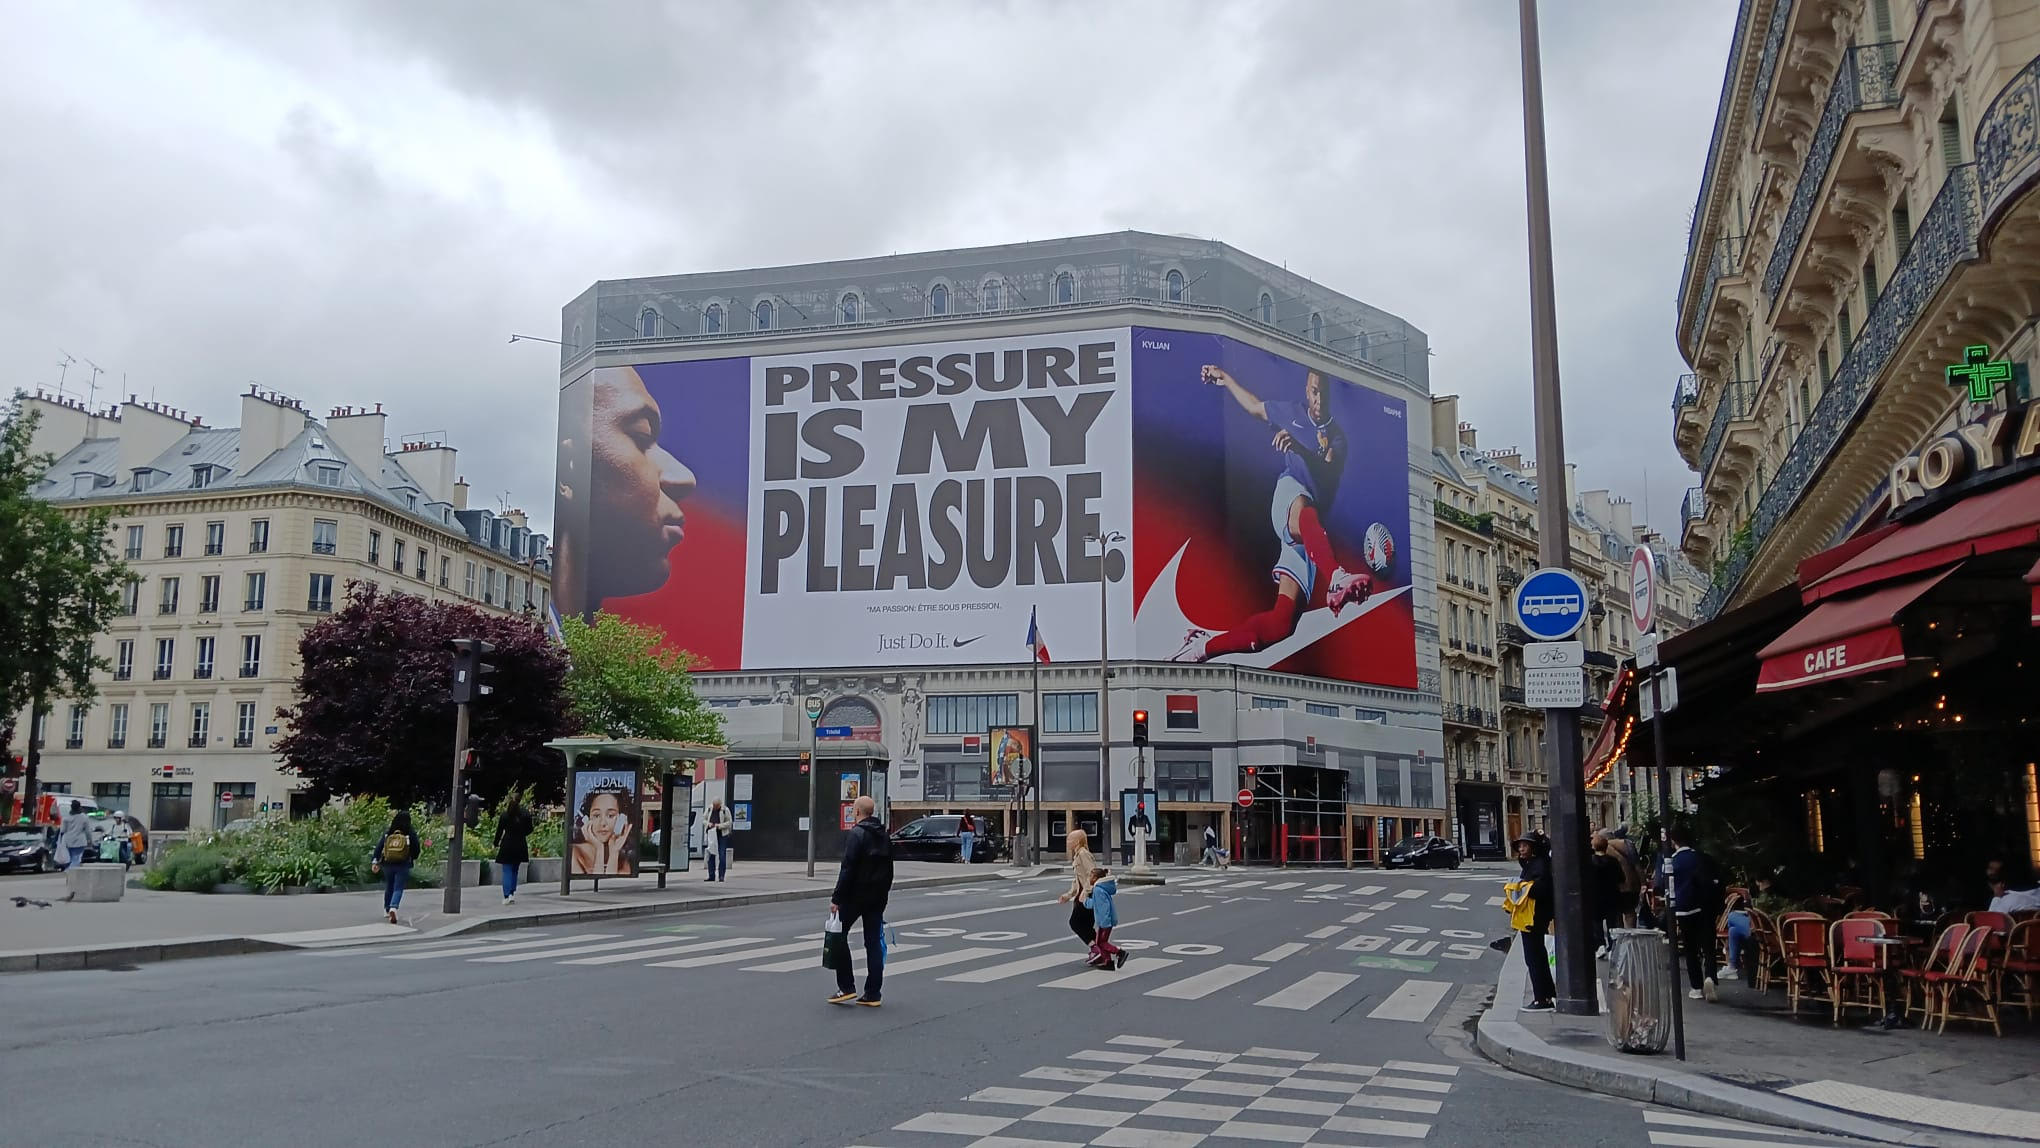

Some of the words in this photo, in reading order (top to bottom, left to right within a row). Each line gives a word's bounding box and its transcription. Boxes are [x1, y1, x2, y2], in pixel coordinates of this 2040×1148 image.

[1142, 340, 1170, 350] KYLIAN
[765, 341, 1116, 406] PRESSURE
[764, 408, 865, 481] IS
[896, 390, 1115, 475] MY
[760, 472, 1126, 594] PLEASURE.
[938, 603, 960, 611] SOUS
[877, 633, 906, 653] Just
[909, 633, 933, 649] Do
[936, 632, 949, 649] It.
[1804, 645, 1847, 673] CAFE
[807, 700, 820, 708] BUS
[577, 775, 634, 788] CAUDALIE
[900, 928, 1028, 941] 30
[1384, 924, 1485, 939] 30
[1335, 934, 1488, 960] BUS
